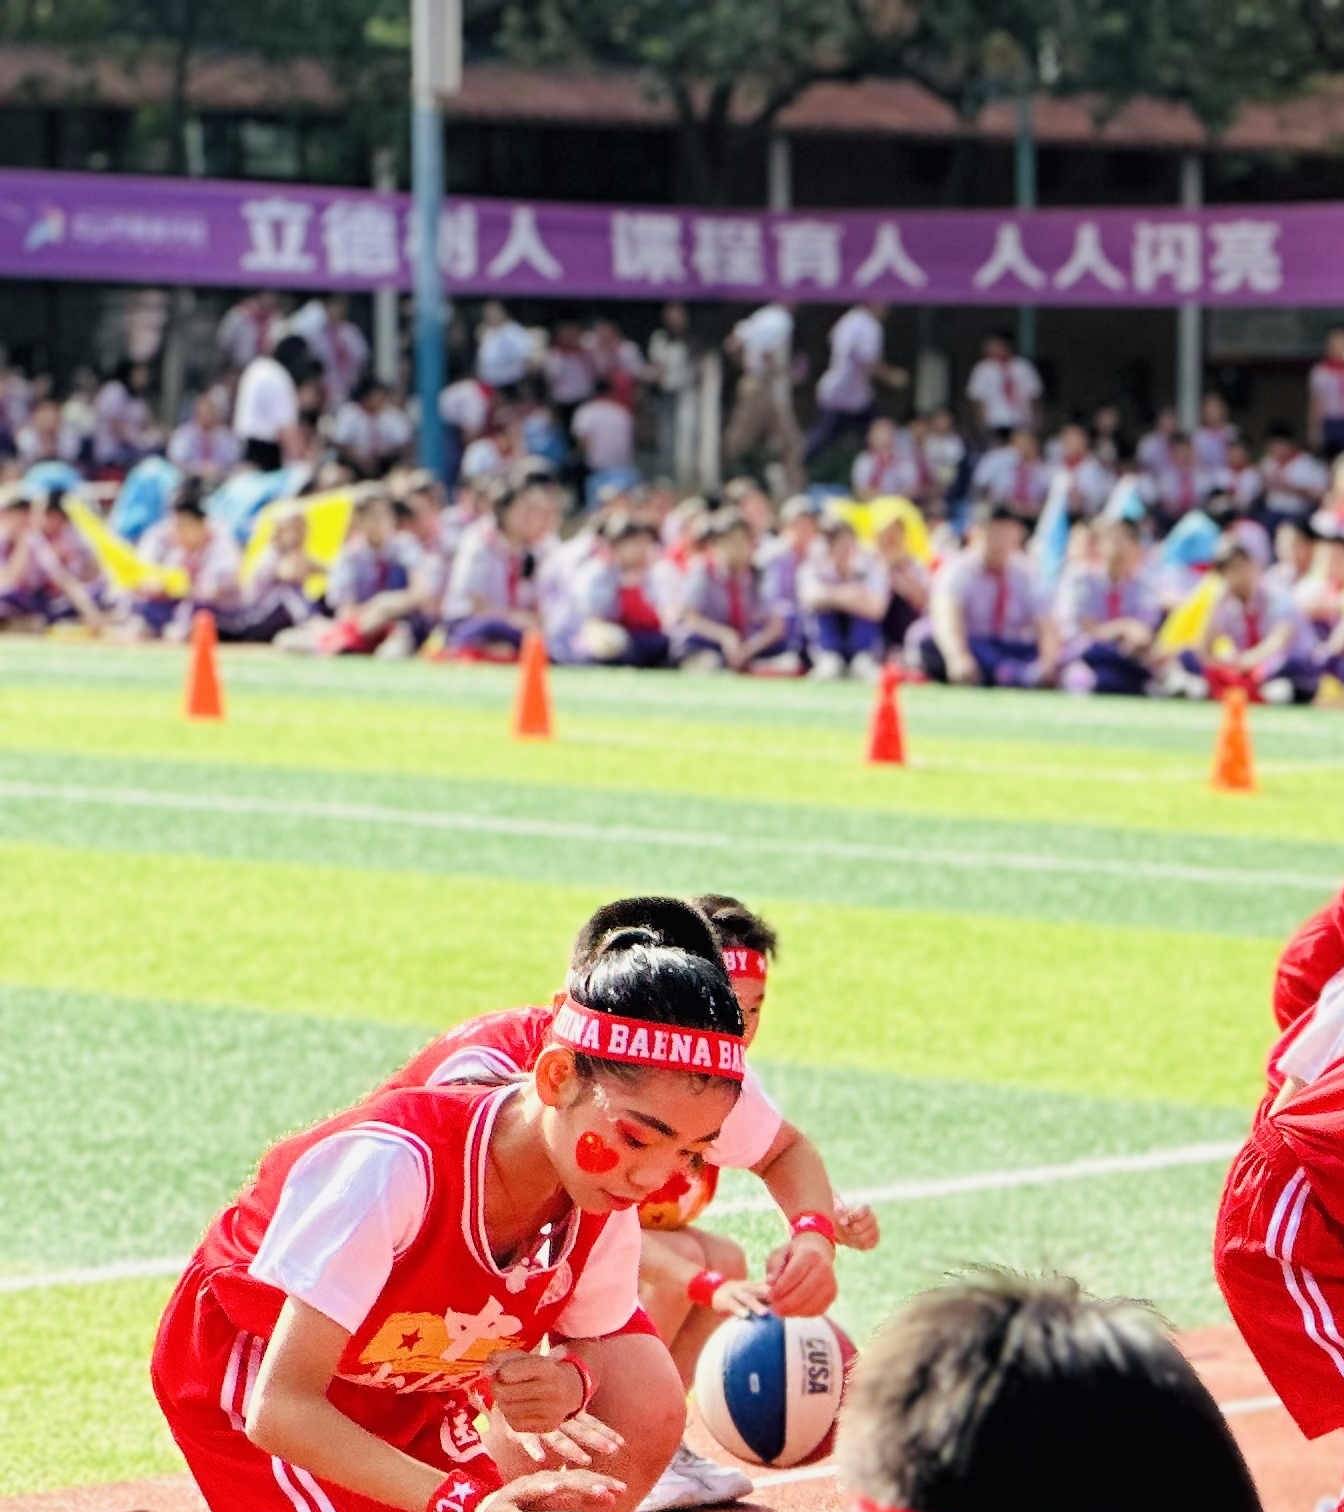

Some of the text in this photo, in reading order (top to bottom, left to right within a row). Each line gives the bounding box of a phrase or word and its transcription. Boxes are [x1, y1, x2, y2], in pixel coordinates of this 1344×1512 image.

[611, 210, 926, 288] 课程育人
[974, 219, 1284, 293] 人人闪亮
